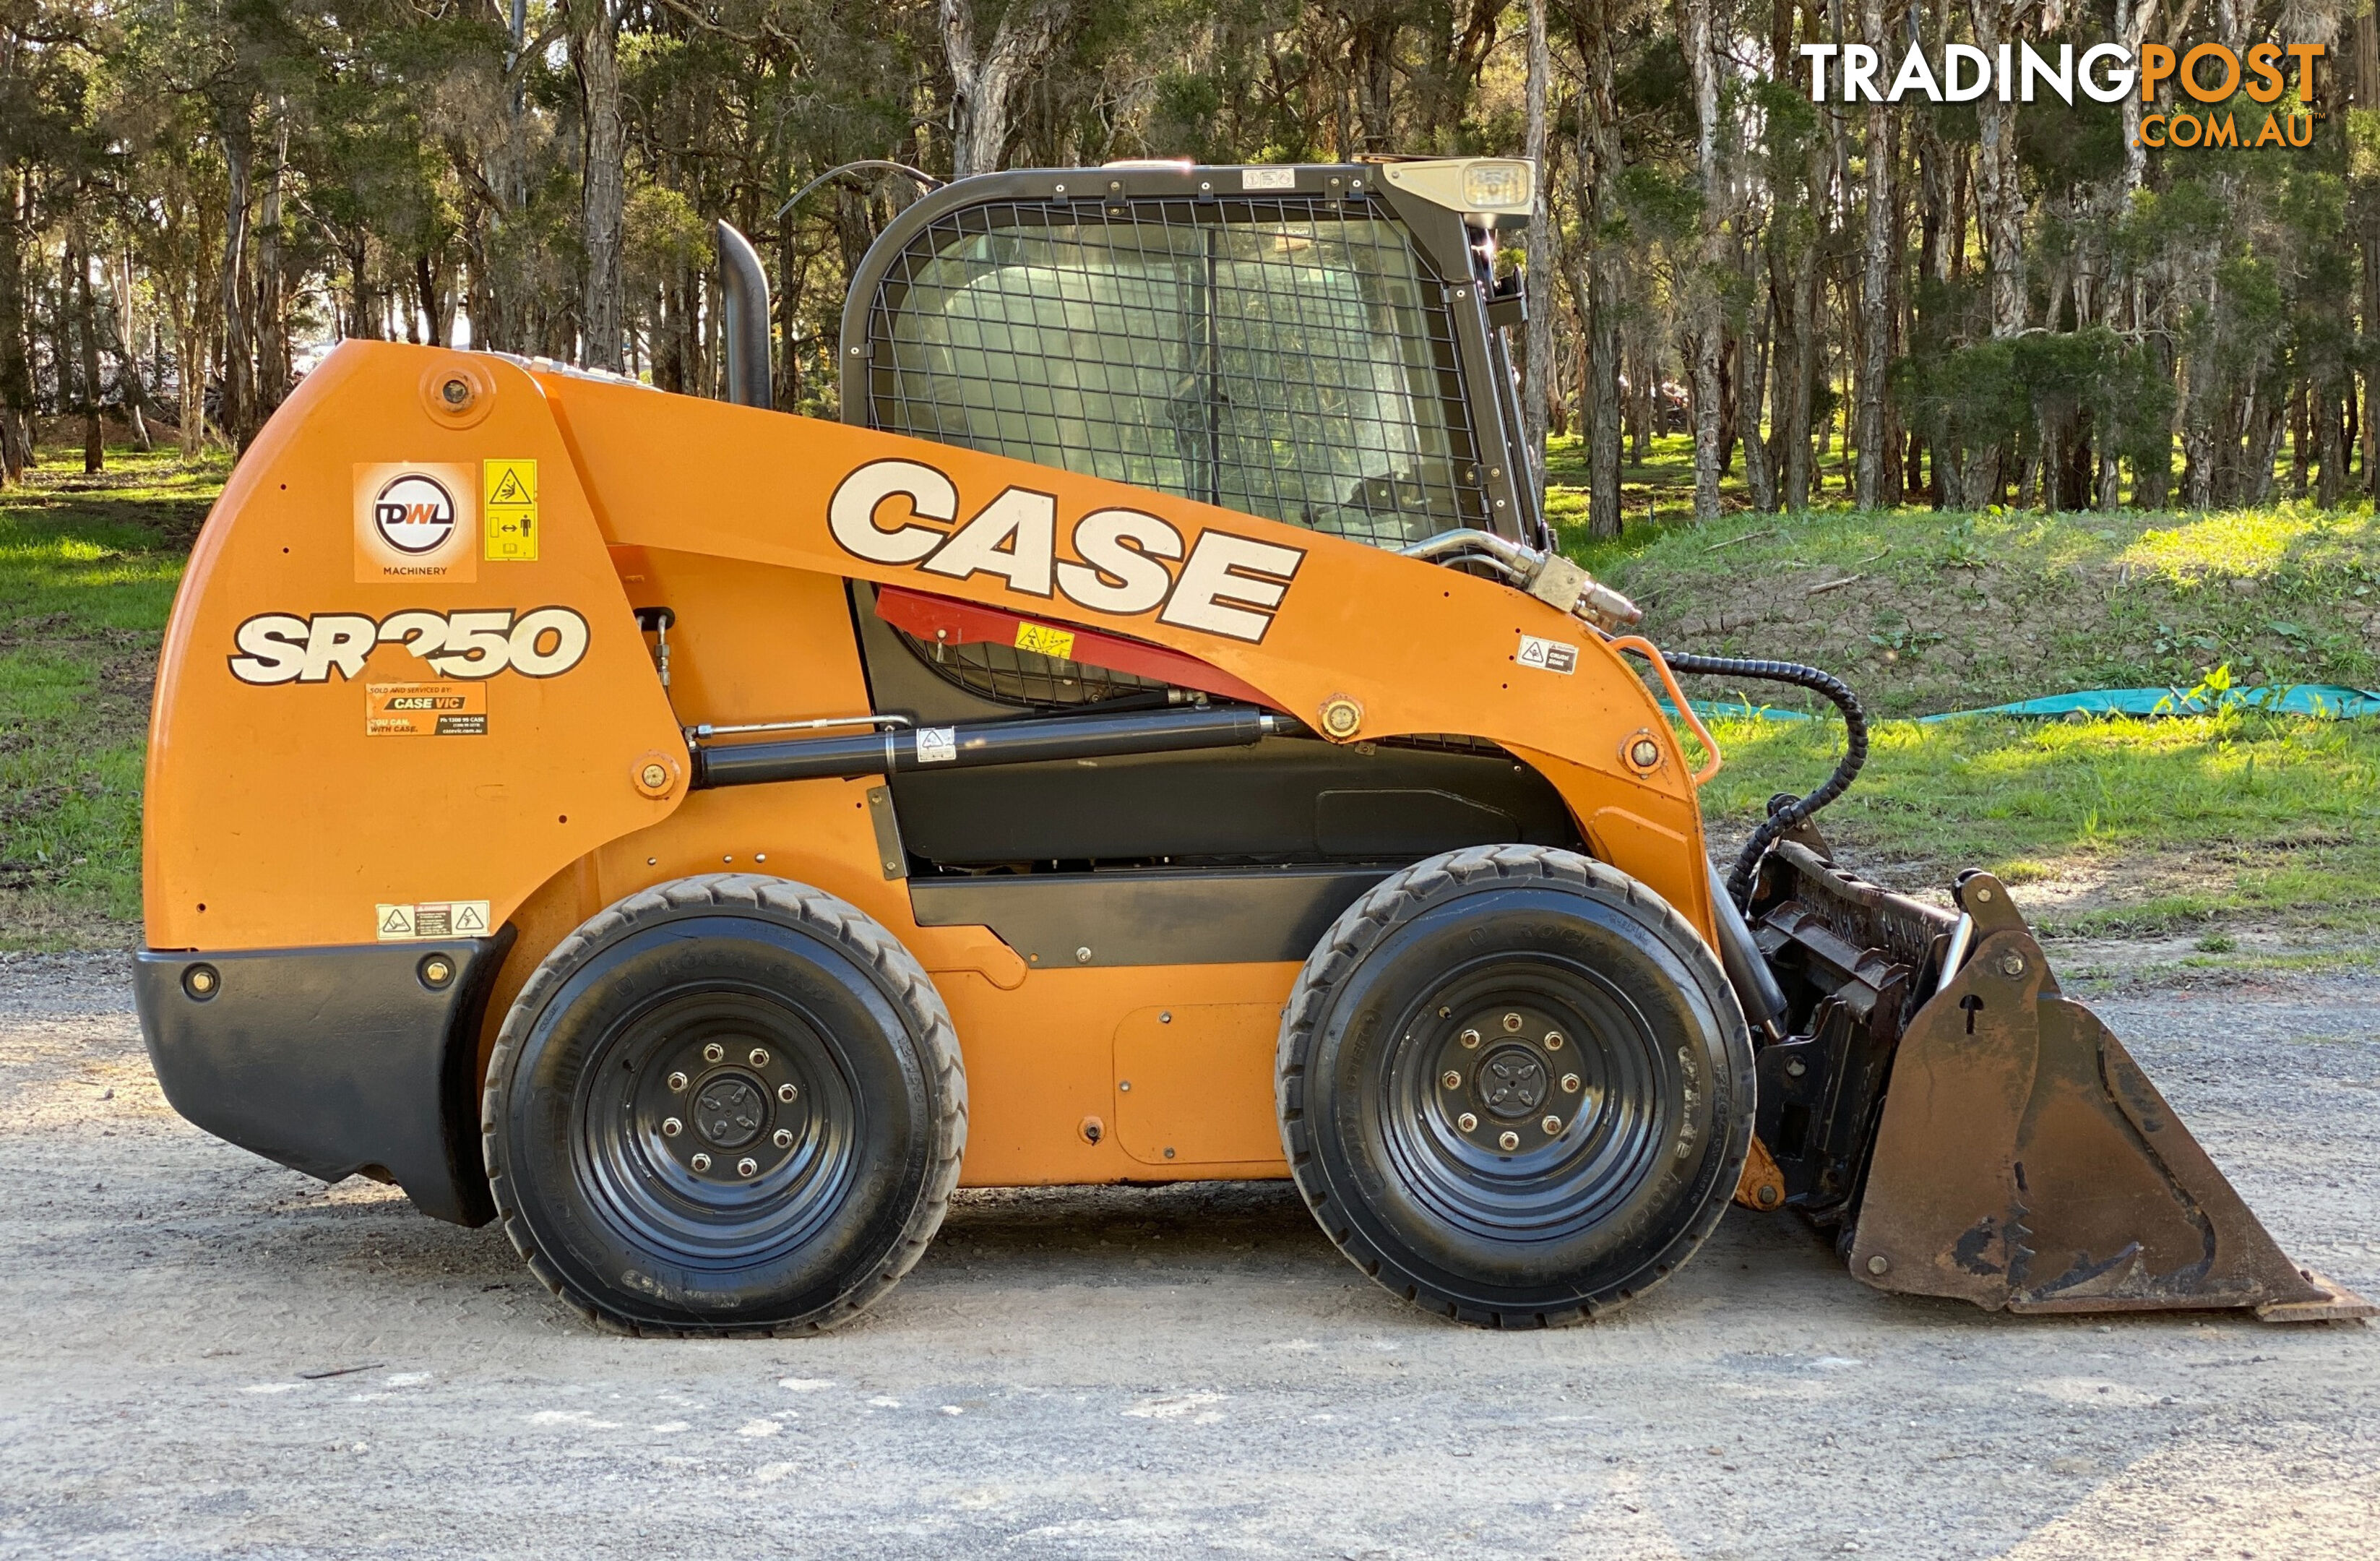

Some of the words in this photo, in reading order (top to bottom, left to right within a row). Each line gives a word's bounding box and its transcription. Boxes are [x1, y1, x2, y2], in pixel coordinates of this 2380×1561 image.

[375, 504, 454, 525] DWL
[827, 457, 1308, 644] CASE
[383, 567, 448, 575] MACHINERY
[226, 605, 591, 686] SR250
[1550, 653, 1569, 661] CRUSH
[394, 698, 433, 709] CASE
[435, 697, 460, 709] VIC
